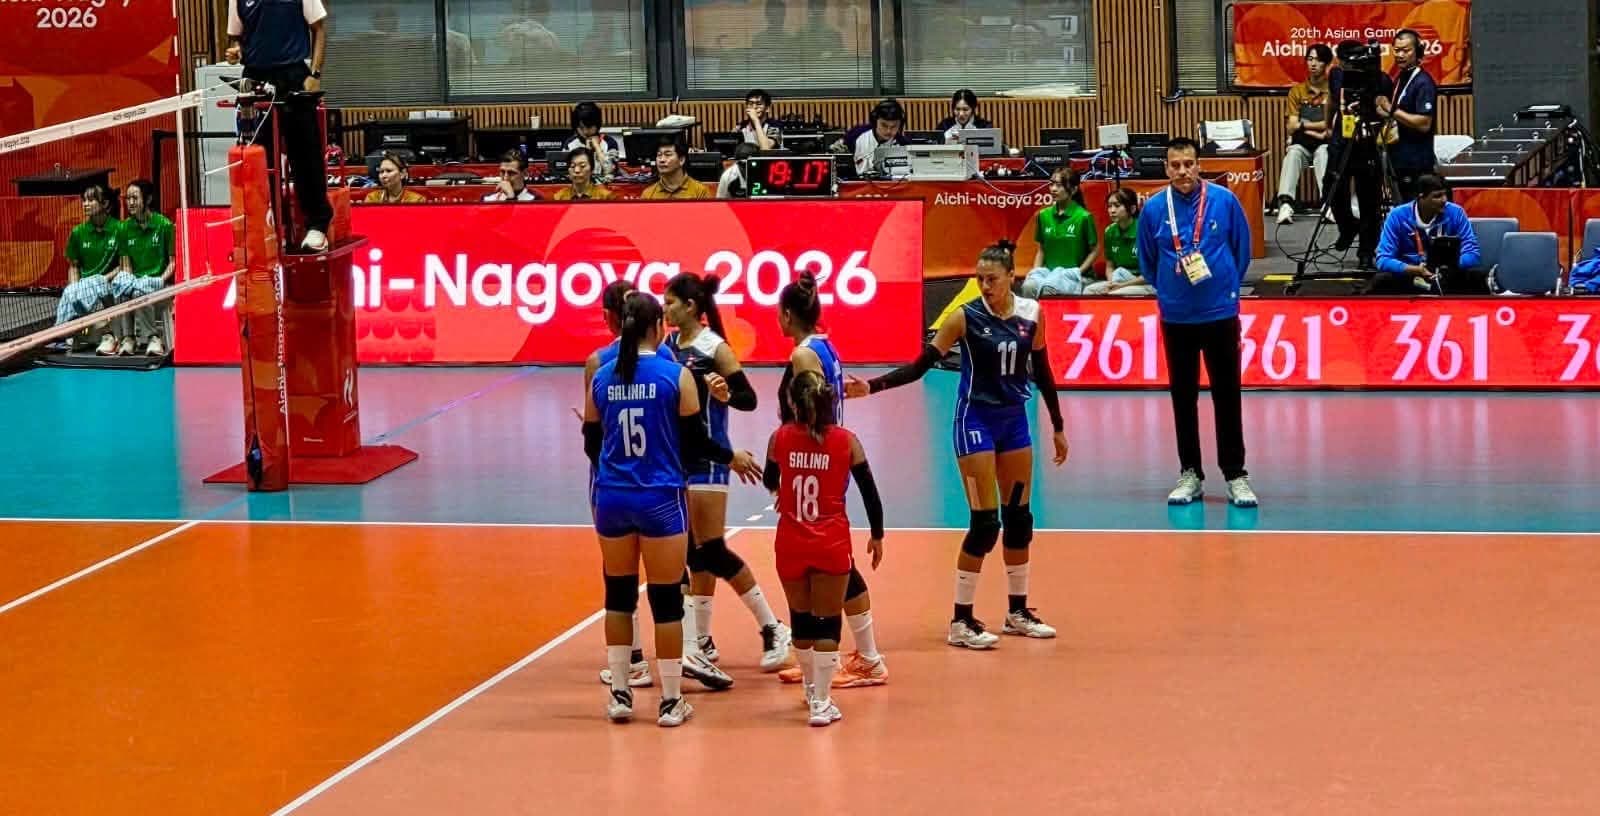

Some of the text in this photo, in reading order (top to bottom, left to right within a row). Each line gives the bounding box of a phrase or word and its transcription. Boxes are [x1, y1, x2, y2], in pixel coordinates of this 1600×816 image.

[36, 7, 98, 28] 2026
[1290, 27, 1400, 39] 20th Asian Gam
[934, 192, 1056, 209] Aichi-Nagoya 20
[222, 248, 878, 325] i-Nagoa 2026
[1390, 306, 1515, 380] 361°
[1557, 314, 1600, 381] 3
[997, 341, 1017, 376] 11
[607, 383, 657, 401] SALINA.B
[618, 407, 647, 457] 15
[789, 451, 830, 471] SALINA
[792, 474, 819, 522] 18
